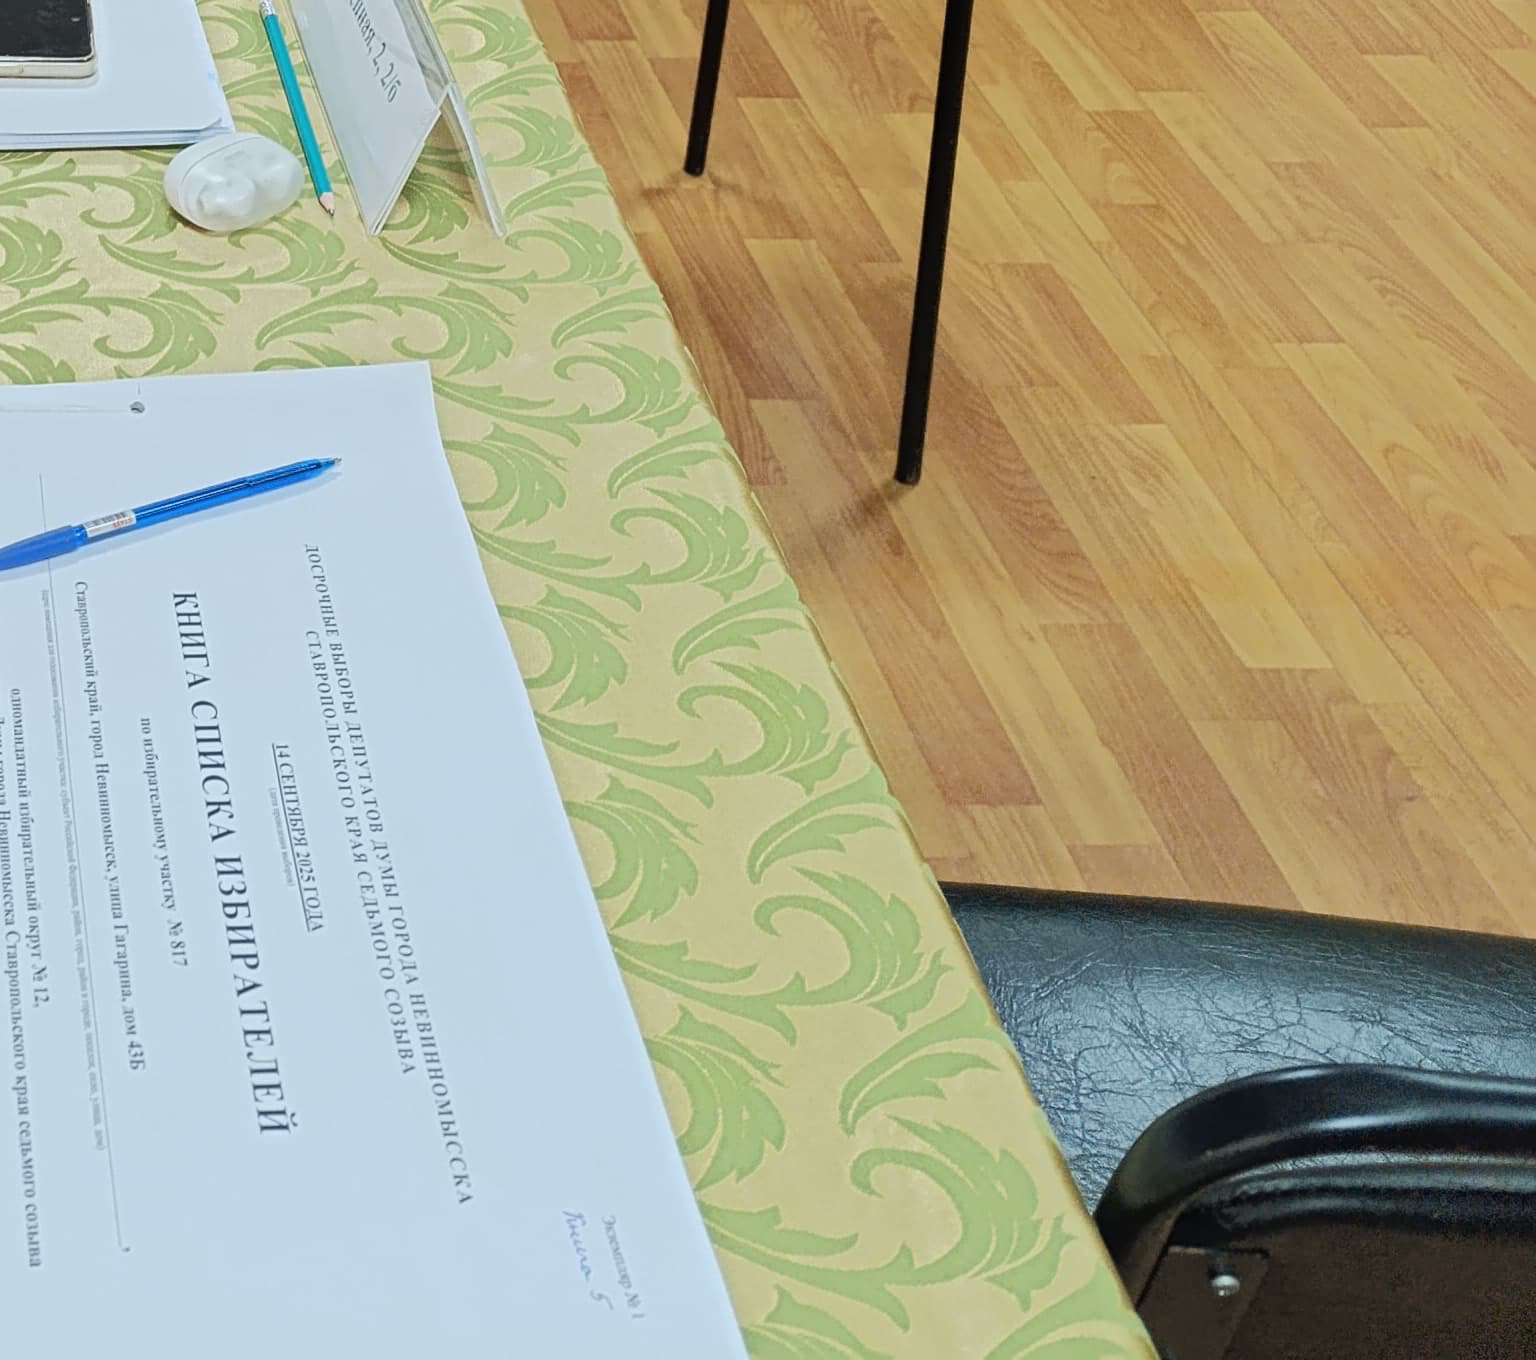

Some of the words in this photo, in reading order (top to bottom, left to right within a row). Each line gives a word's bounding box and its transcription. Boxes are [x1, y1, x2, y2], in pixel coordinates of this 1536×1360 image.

[372, 42, 387, 77] 2,
[73, 581, 99, 678] Ставропольский
[172, 591, 212, 689] КНИГА
[83, 680, 103, 717] край,
[10, 688, 32, 798] одномандатный
[87, 720, 104, 759] город
[139, 717, 154, 735] по
[190, 700, 237, 843] СПИСКА
[274, 743, 291, 760] 14
[142, 738, 167, 850] избирательному
[279, 762, 309, 847] СЕНТЯБРЯ
[95, 763, 117, 873] Невинномысск,
[16, 802, 41, 912] избирательный
[296, 851, 316, 883] 2025
[304, 543, 340, 637] ДОСРОЧНЫЕ
[328, 642, 358, 714] ВЫБОРЫ
[344, 720, 384, 833] ДЕПУТАТОВ
[370, 839, 400, 897] ДУМЫ
[387, 905, 419, 985] ГОРОДА
[408, 993, 473, 1205] НЕВИННОМЫССКА
[305, 630, 356, 809] СТАВРОПОЛЬСКОГО
[344, 815, 369, 863] КРАЯ
[357, 870, 396, 980] СЕДЬМОГО
[383, 988, 416, 1075] СОЗЫВА
[104, 875, 123, 920] улица
[154, 854, 176, 911] участку
[167, 919, 184, 937] №
[303, 886, 324, 932] ГОДА
[24, 915, 42, 960] округ
[170, 940, 189, 967] 817
[31, 964, 48, 982] №
[112, 924, 133, 1003] Гагарина,
[3, 930, 26, 1071] Ставропольского
[33, 987, 51, 1008] 12,
[214, 854, 299, 1135] ИЗБИРАТЕЛЕЙ
[122, 1006, 137, 1036] дом
[127, 1040, 146, 1071] 43Б
[11, 1075, 30, 1116] края
[18, 1120, 36, 1199] седьмого
[24, 1203, 42, 1268] созыва
[624, 1291, 641, 1309] №
